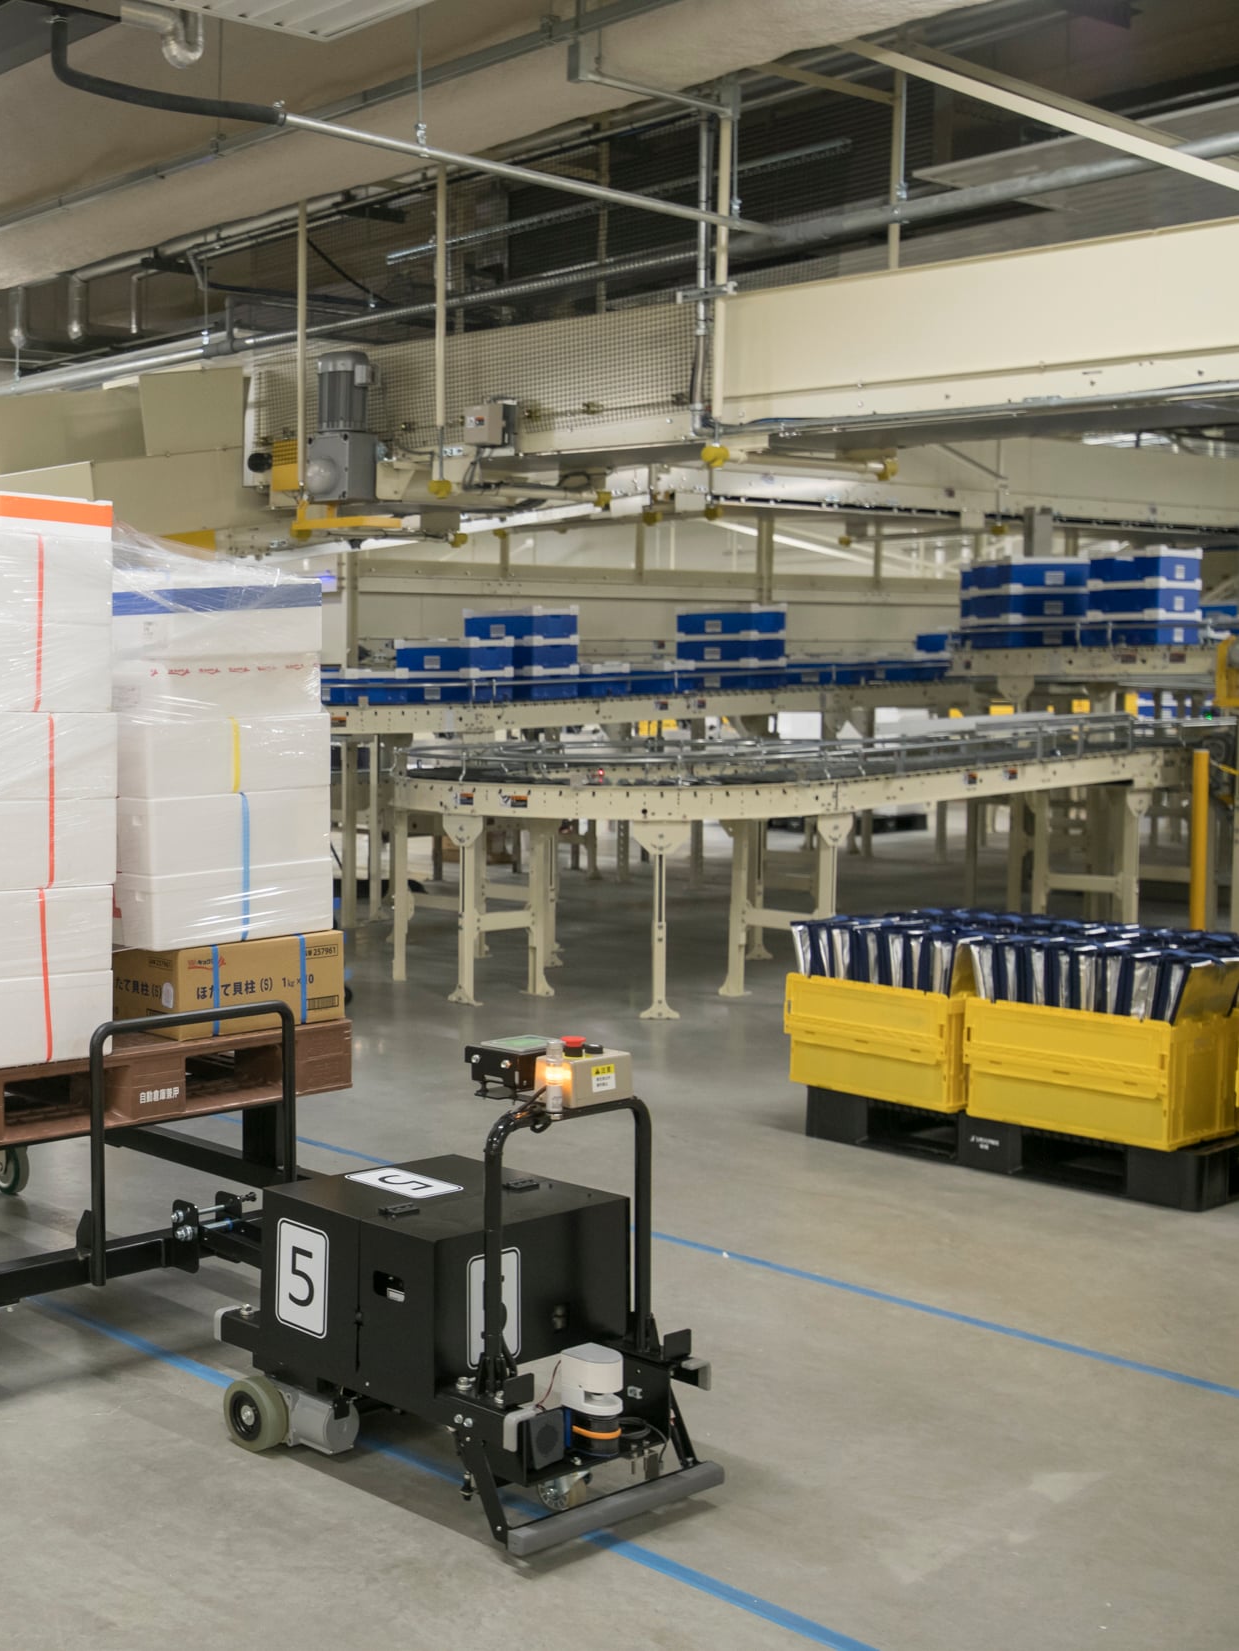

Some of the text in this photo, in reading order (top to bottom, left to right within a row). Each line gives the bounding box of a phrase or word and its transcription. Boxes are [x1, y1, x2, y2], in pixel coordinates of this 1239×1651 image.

[313, 946, 336, 956] 257961
[377, 1174, 435, 1193] 5
[288, 1245, 315, 1308] 5
